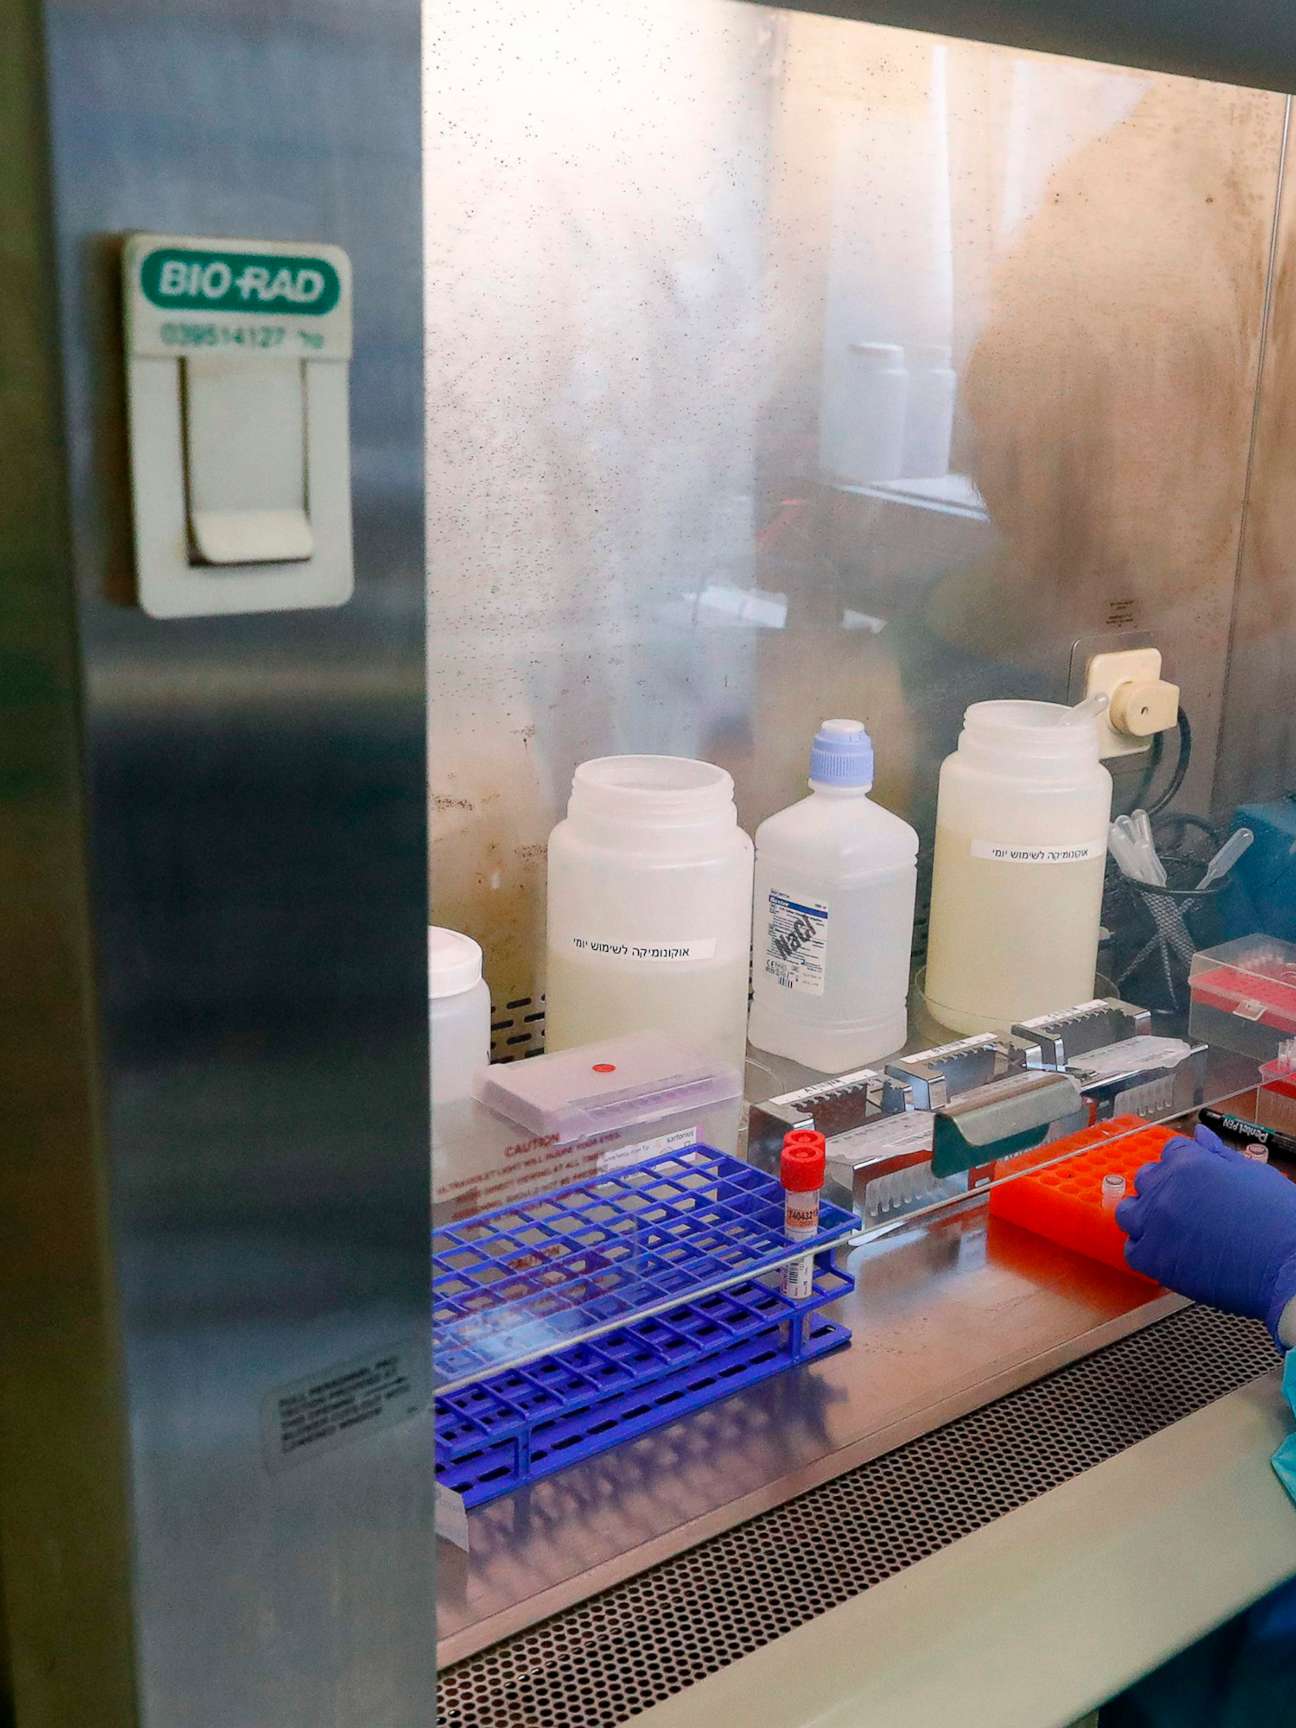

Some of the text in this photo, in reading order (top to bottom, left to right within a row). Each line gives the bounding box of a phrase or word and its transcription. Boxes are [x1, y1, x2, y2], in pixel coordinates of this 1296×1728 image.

[158, 261, 325, 304] BIO-RAD
[1010, 848, 1045, 861] לשימוש
[573, 936, 691, 960] אוקונומיקה לשימוש יומי
[504, 1132, 561, 1158] CAUTION
